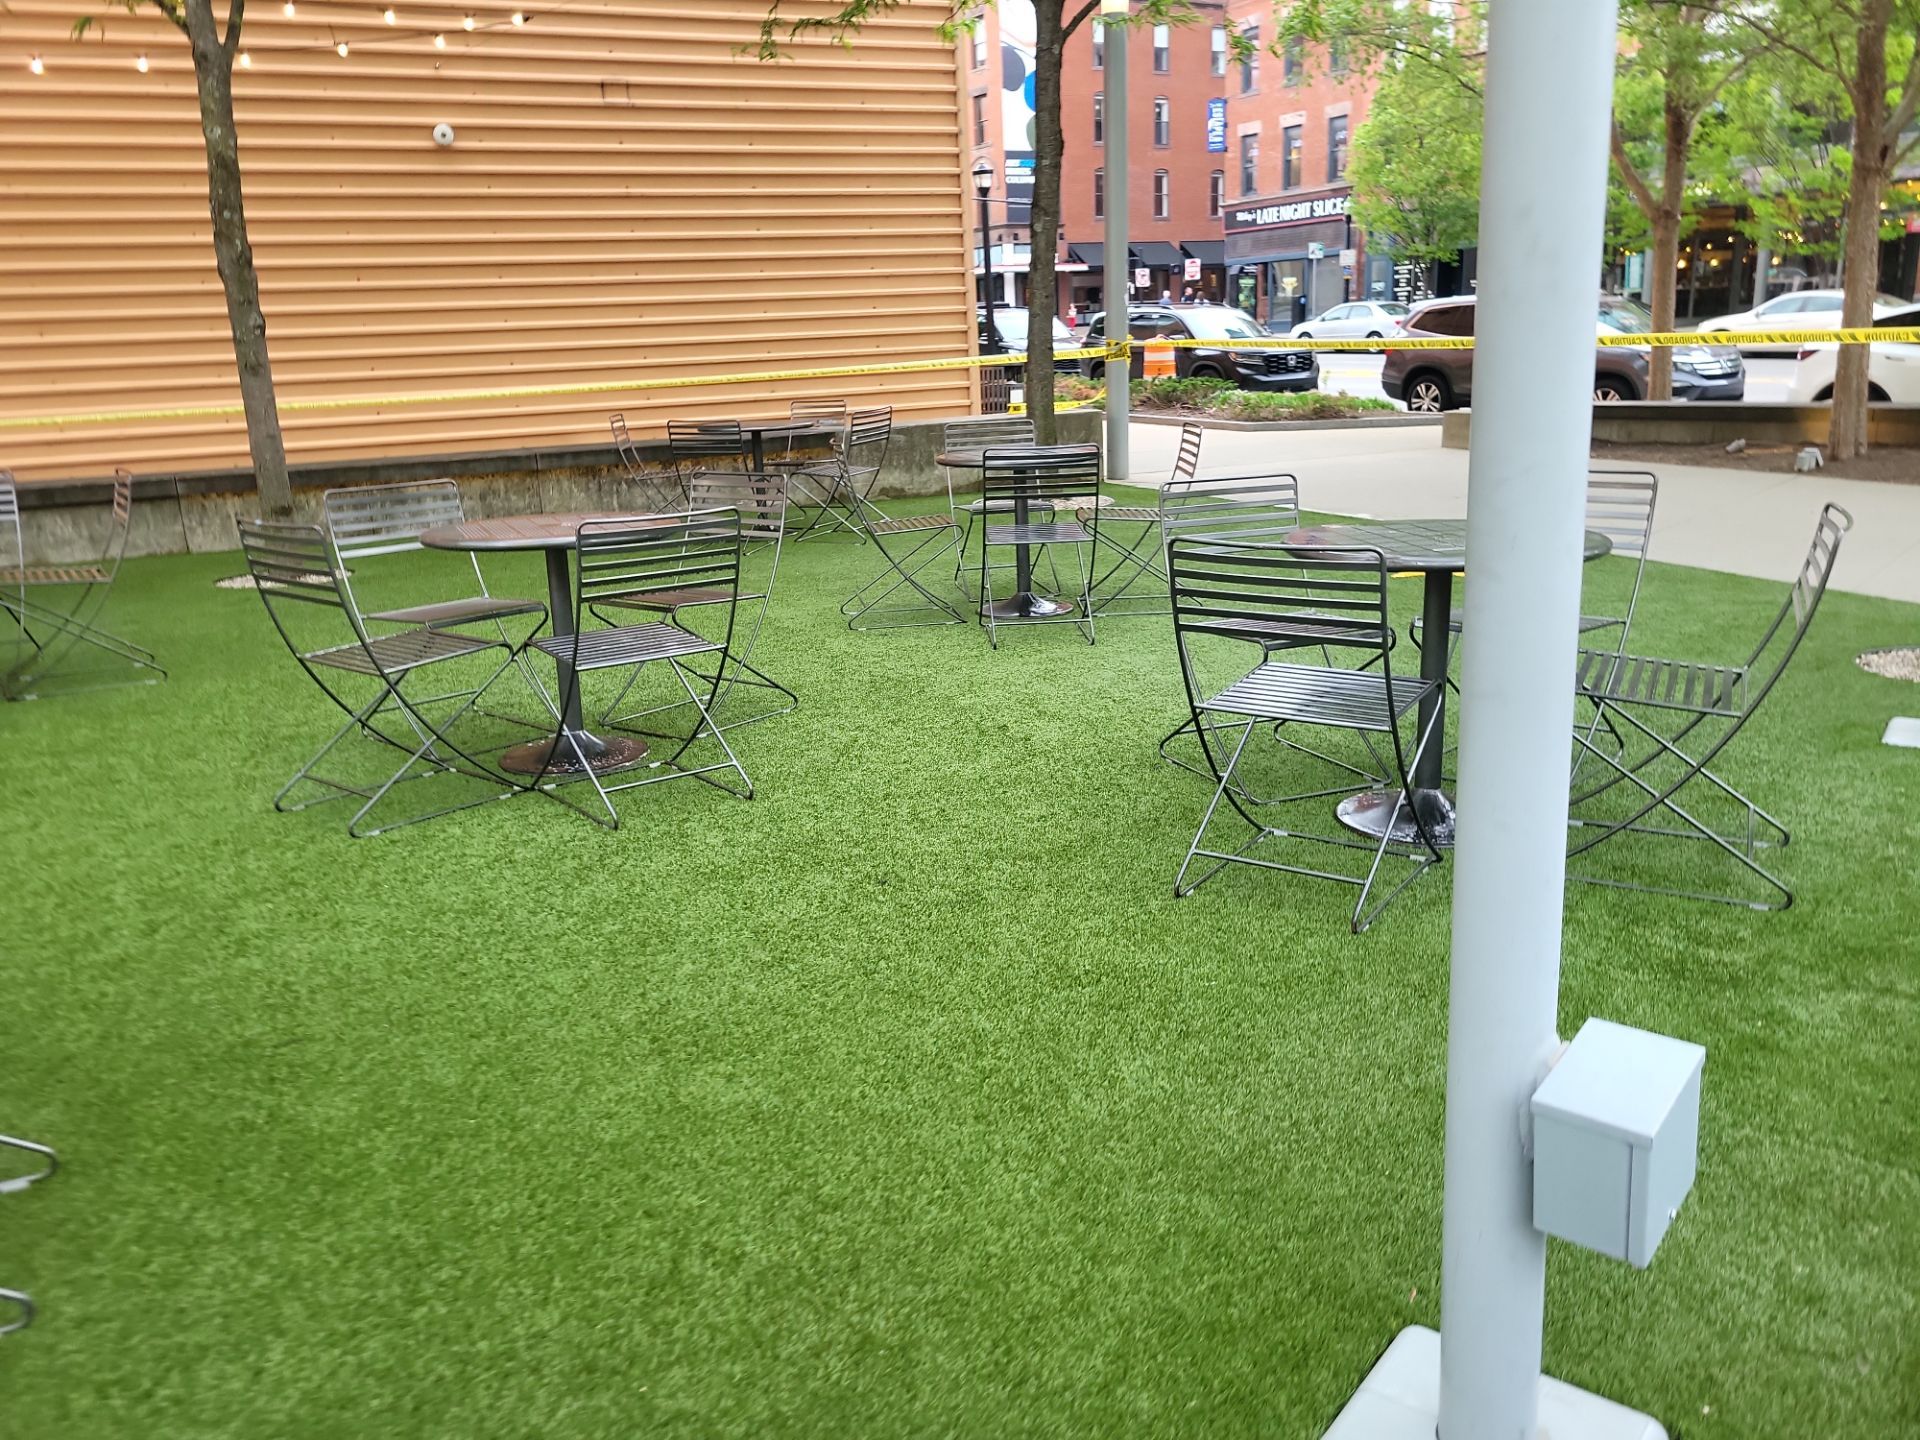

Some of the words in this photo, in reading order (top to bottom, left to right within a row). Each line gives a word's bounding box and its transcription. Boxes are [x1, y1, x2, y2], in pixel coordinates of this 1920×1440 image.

[1256, 206, 1280, 225] LATE
[1280, 202, 1312, 221] NIGHT
[1312, 197, 1344, 217] SLICE
